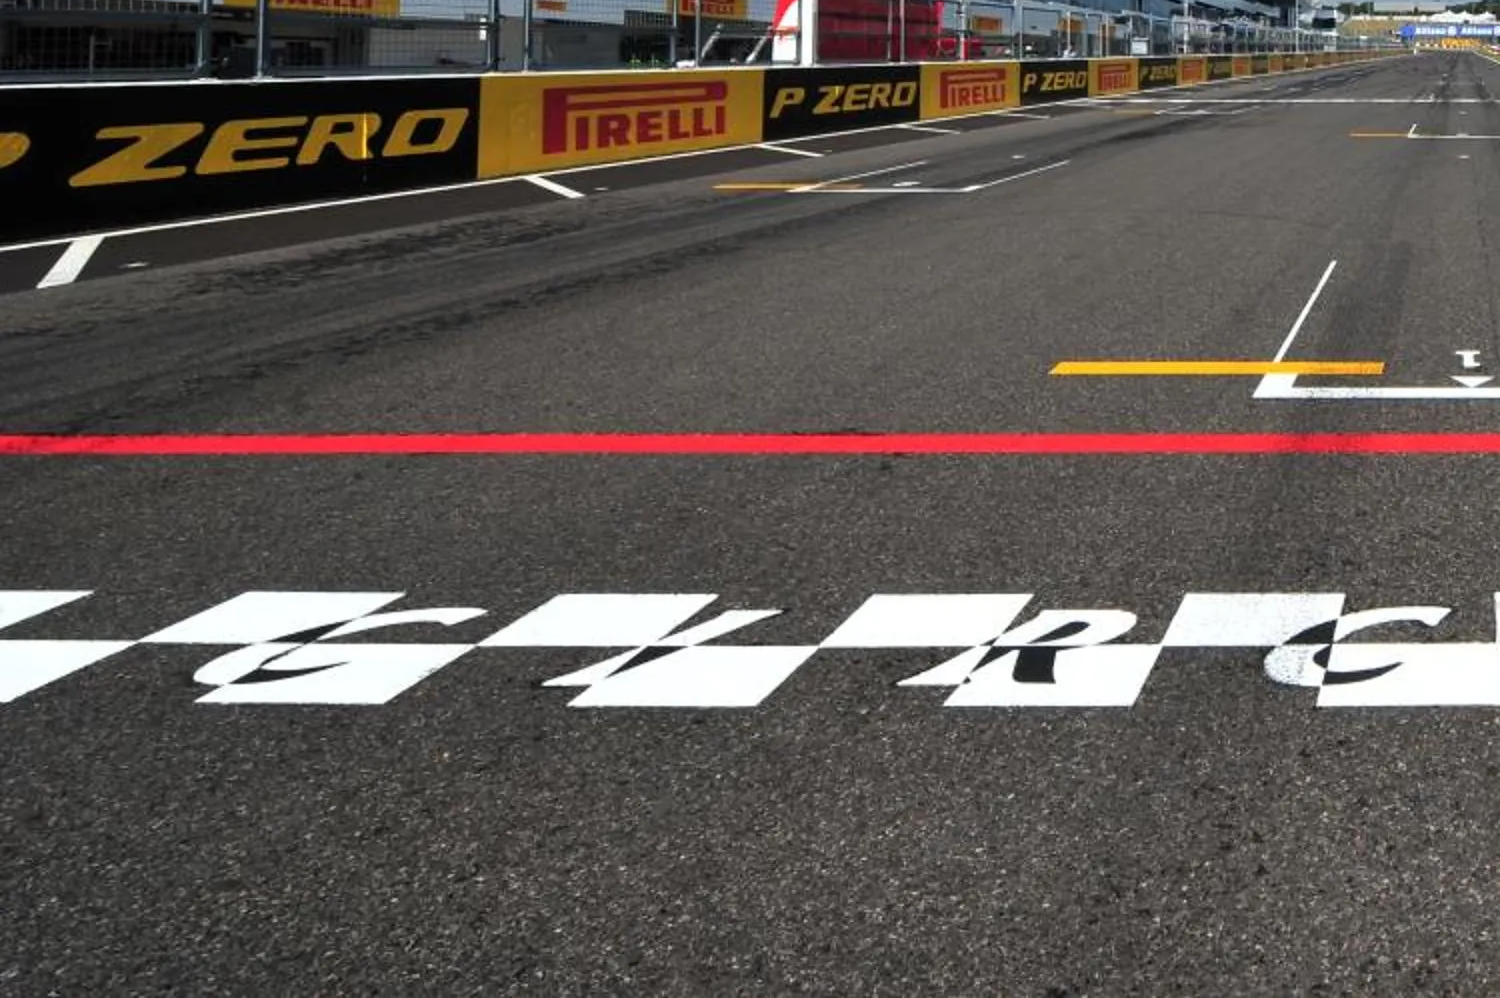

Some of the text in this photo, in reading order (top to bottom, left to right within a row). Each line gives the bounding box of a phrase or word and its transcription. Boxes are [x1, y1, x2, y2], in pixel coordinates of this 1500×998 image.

[769, 81, 917, 119] P ZERO
[939, 68, 1006, 109] PIRELLI
[1023, 71, 1088, 92] P ZERO
[542, 80, 729, 154] PIRELLI
[68, 107, 469, 187] ZERO
